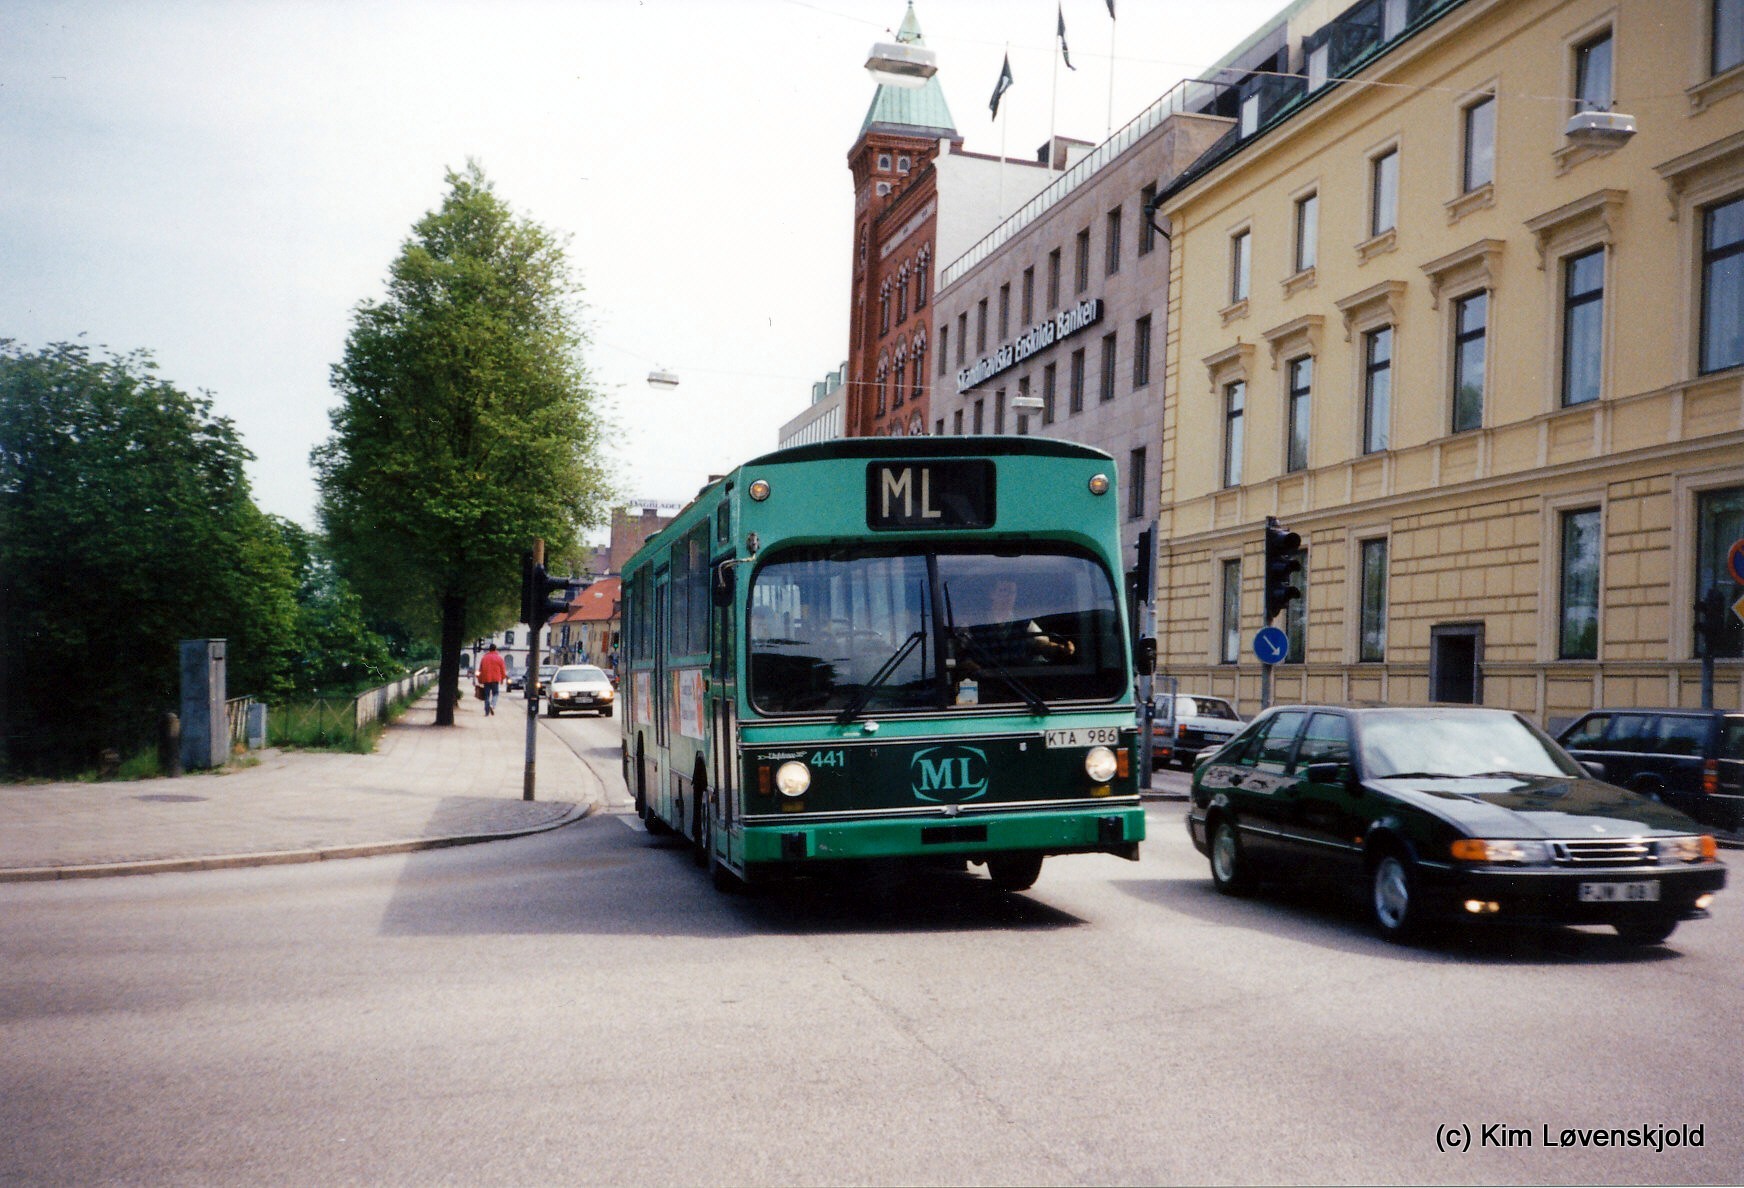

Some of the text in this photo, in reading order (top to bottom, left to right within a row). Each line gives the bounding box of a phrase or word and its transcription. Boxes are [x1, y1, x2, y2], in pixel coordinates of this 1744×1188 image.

[1015, 321, 1054, 363] Enskilda
[1056, 299, 1097, 340] Banken
[881, 467, 942, 518] ML
[1048, 729, 1116, 746] KTA 986
[810, 750, 845, 767] 441
[918, 757, 985, 790] ML
